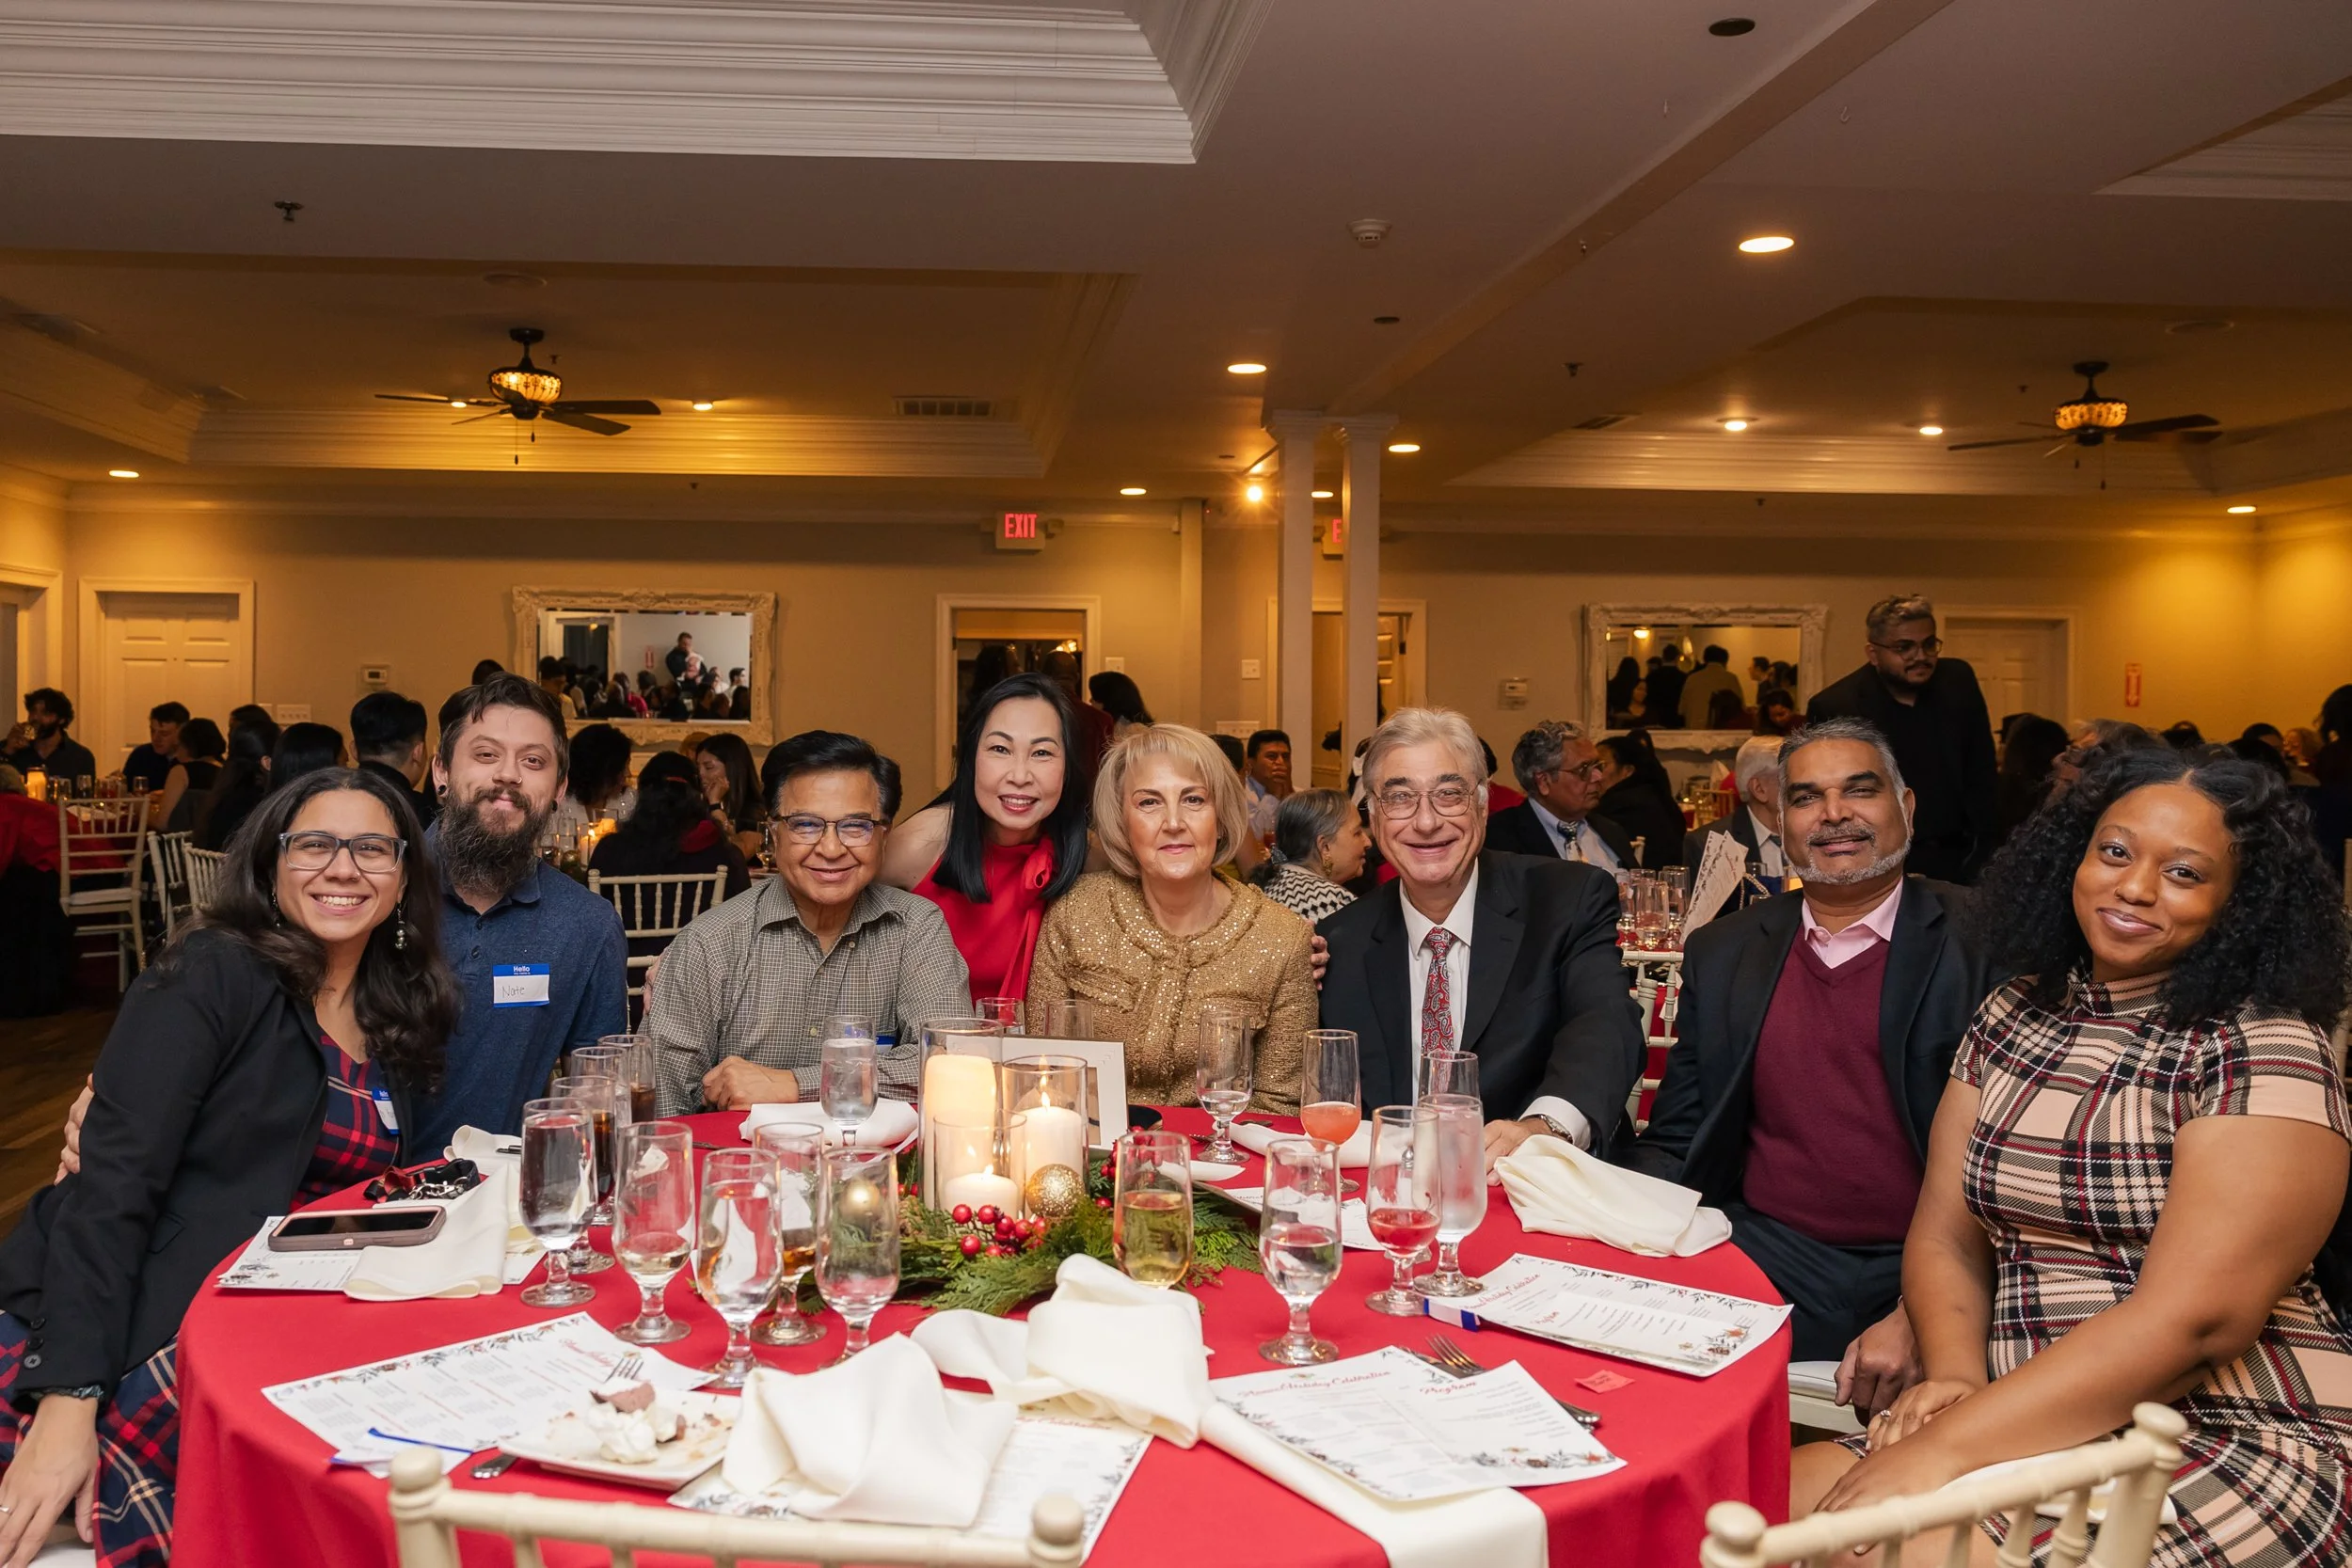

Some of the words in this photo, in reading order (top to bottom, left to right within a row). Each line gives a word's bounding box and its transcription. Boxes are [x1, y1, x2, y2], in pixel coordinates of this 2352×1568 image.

[1005, 513, 1038, 538] EXIT
[1332, 1370, 1391, 1386] Celebration
[1419, 1381, 1476, 1395] Program
